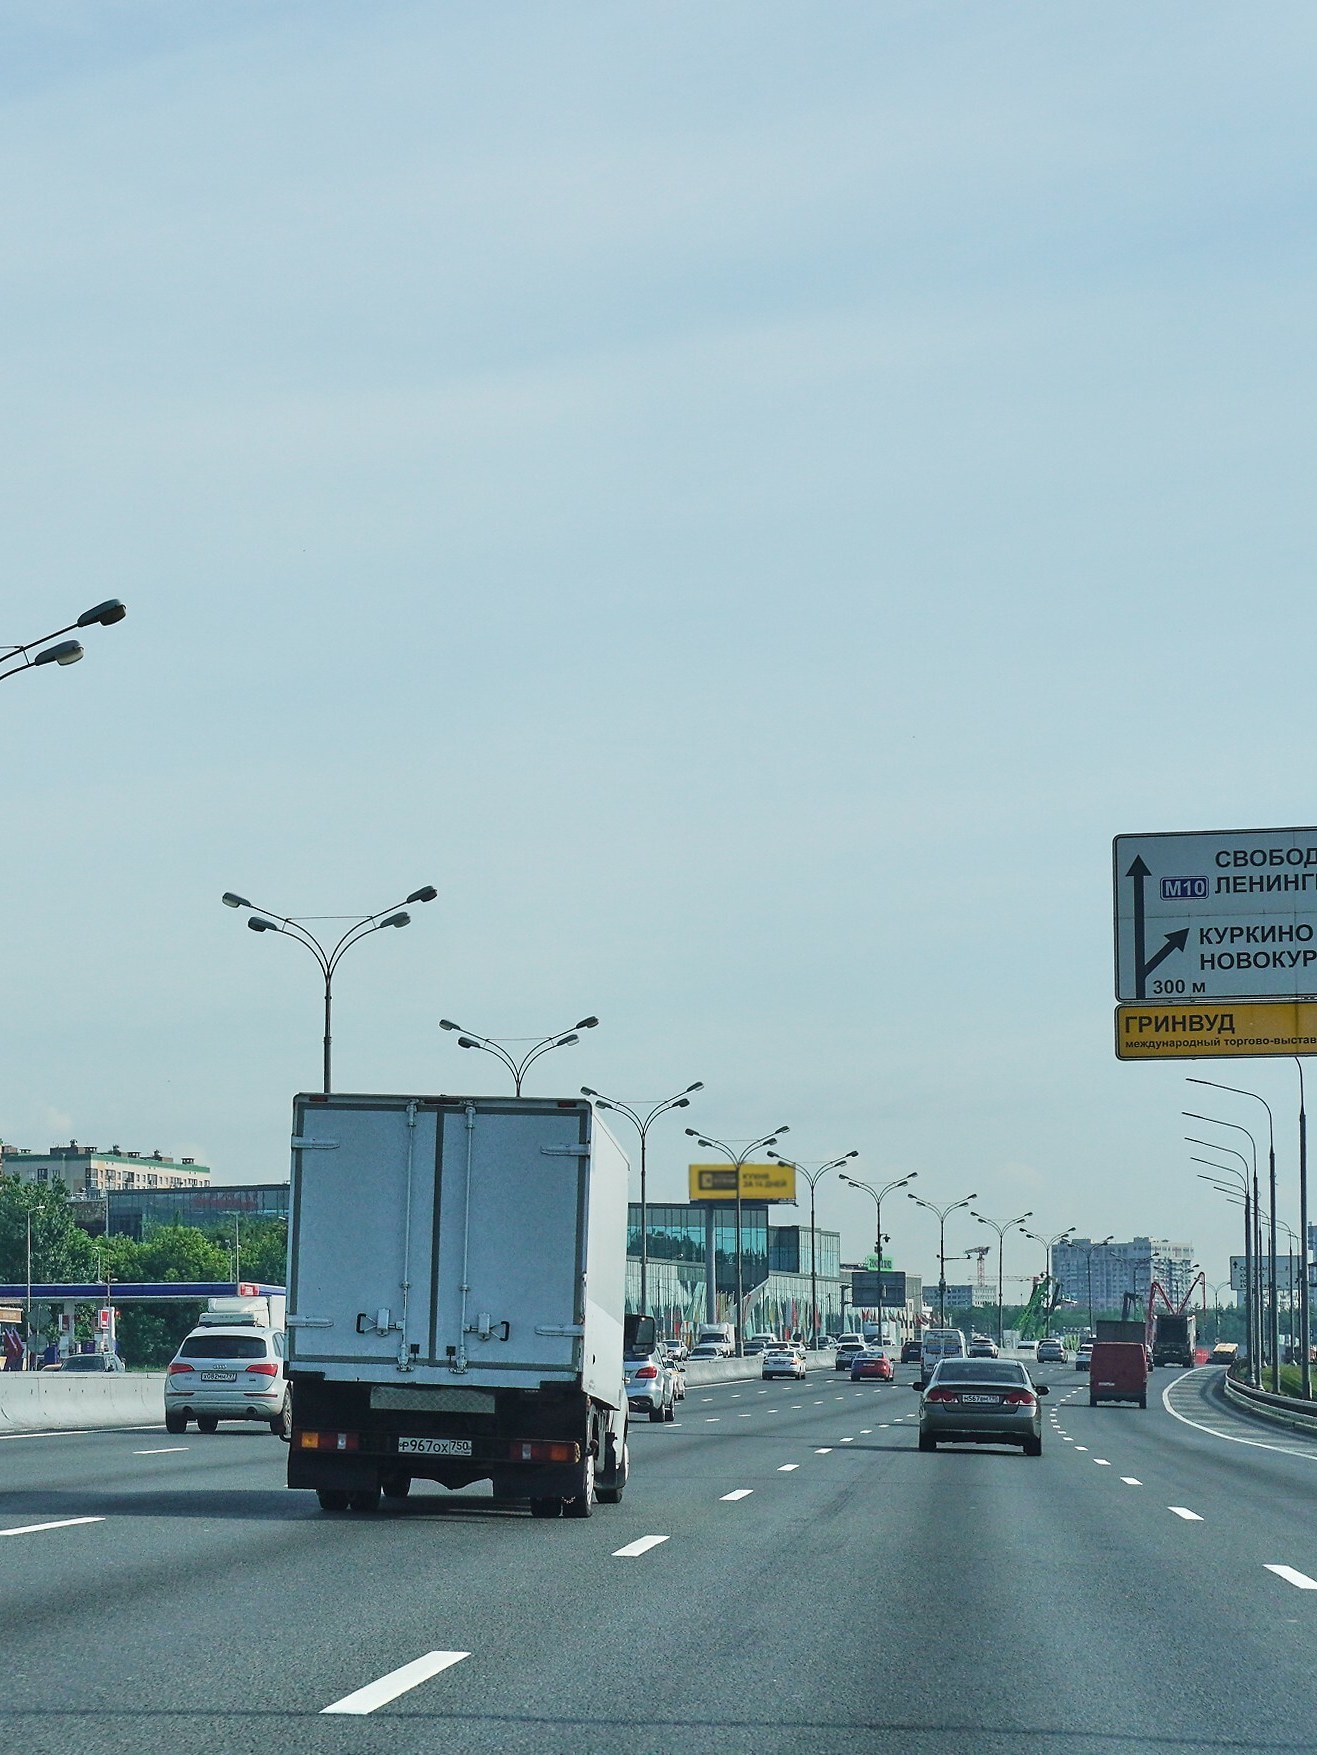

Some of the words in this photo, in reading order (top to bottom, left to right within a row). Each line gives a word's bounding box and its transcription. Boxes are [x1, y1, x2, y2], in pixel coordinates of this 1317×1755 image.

[1215, 847, 1317, 868] СВОБОД
[1165, 880, 1206, 897] М10
[1215, 873, 1317, 894] ЛЕНИНГ
[1199, 924, 1314, 945] КУРКИНО
[1200, 950, 1317, 971] НОВОКУР
[1153, 979, 1185, 994] 300
[1125, 1013, 1235, 1034] ГРИНВУД
[1125, 1037, 1221, 1050] международный
[1224, 1037, 1317, 1047] торгово-выстав
